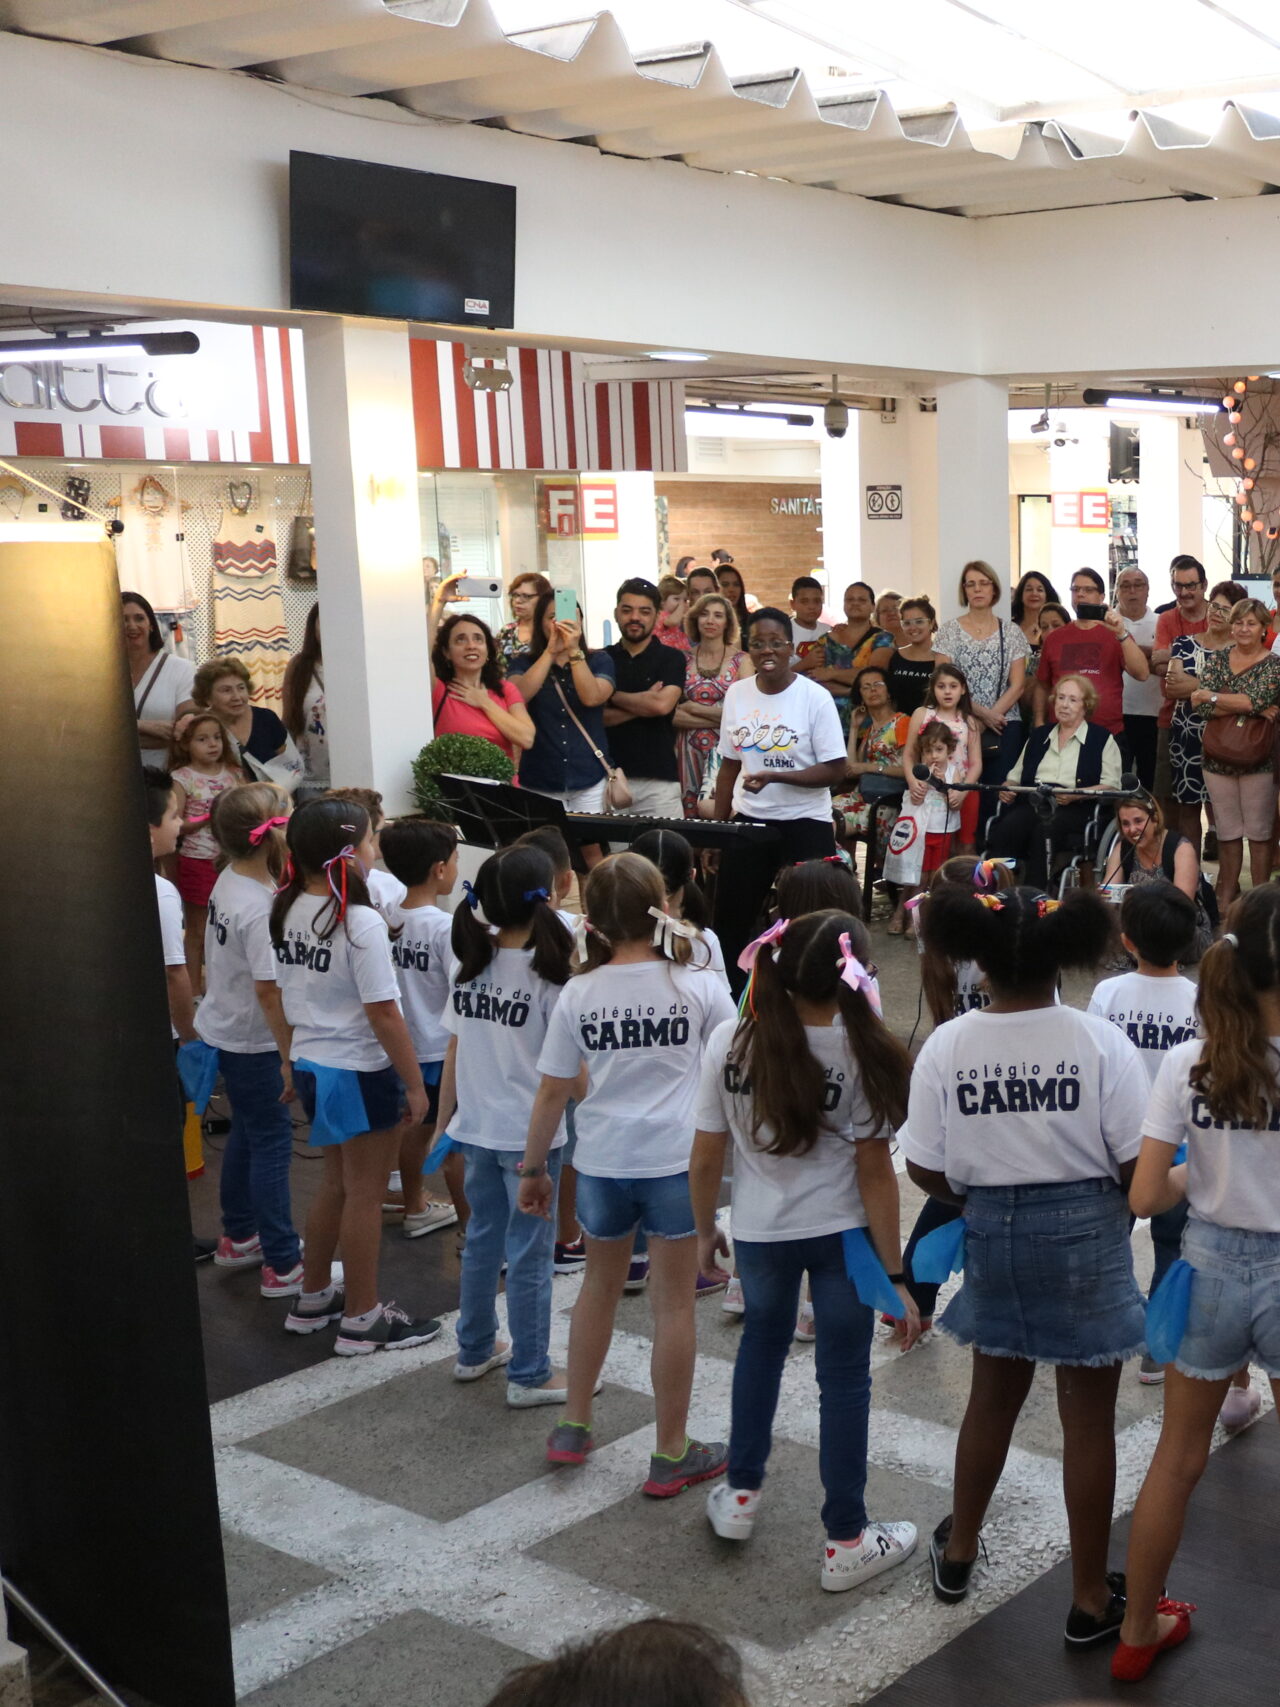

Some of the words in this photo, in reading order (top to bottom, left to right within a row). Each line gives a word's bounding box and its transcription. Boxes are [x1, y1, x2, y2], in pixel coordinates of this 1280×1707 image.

[763, 758, 795, 768] CARMO
[512, 988, 532, 1001] do
[453, 990, 530, 1028] CARMO
[580, 1004, 655, 1023] colégio
[669, 1003, 689, 1015] do
[1109, 1010, 1174, 1025] colégio
[581, 1017, 690, 1051] CARMO
[956, 1061, 1041, 1081] colégio
[1056, 1060, 1079, 1075] do
[956, 1077, 1081, 1116] CARMO
